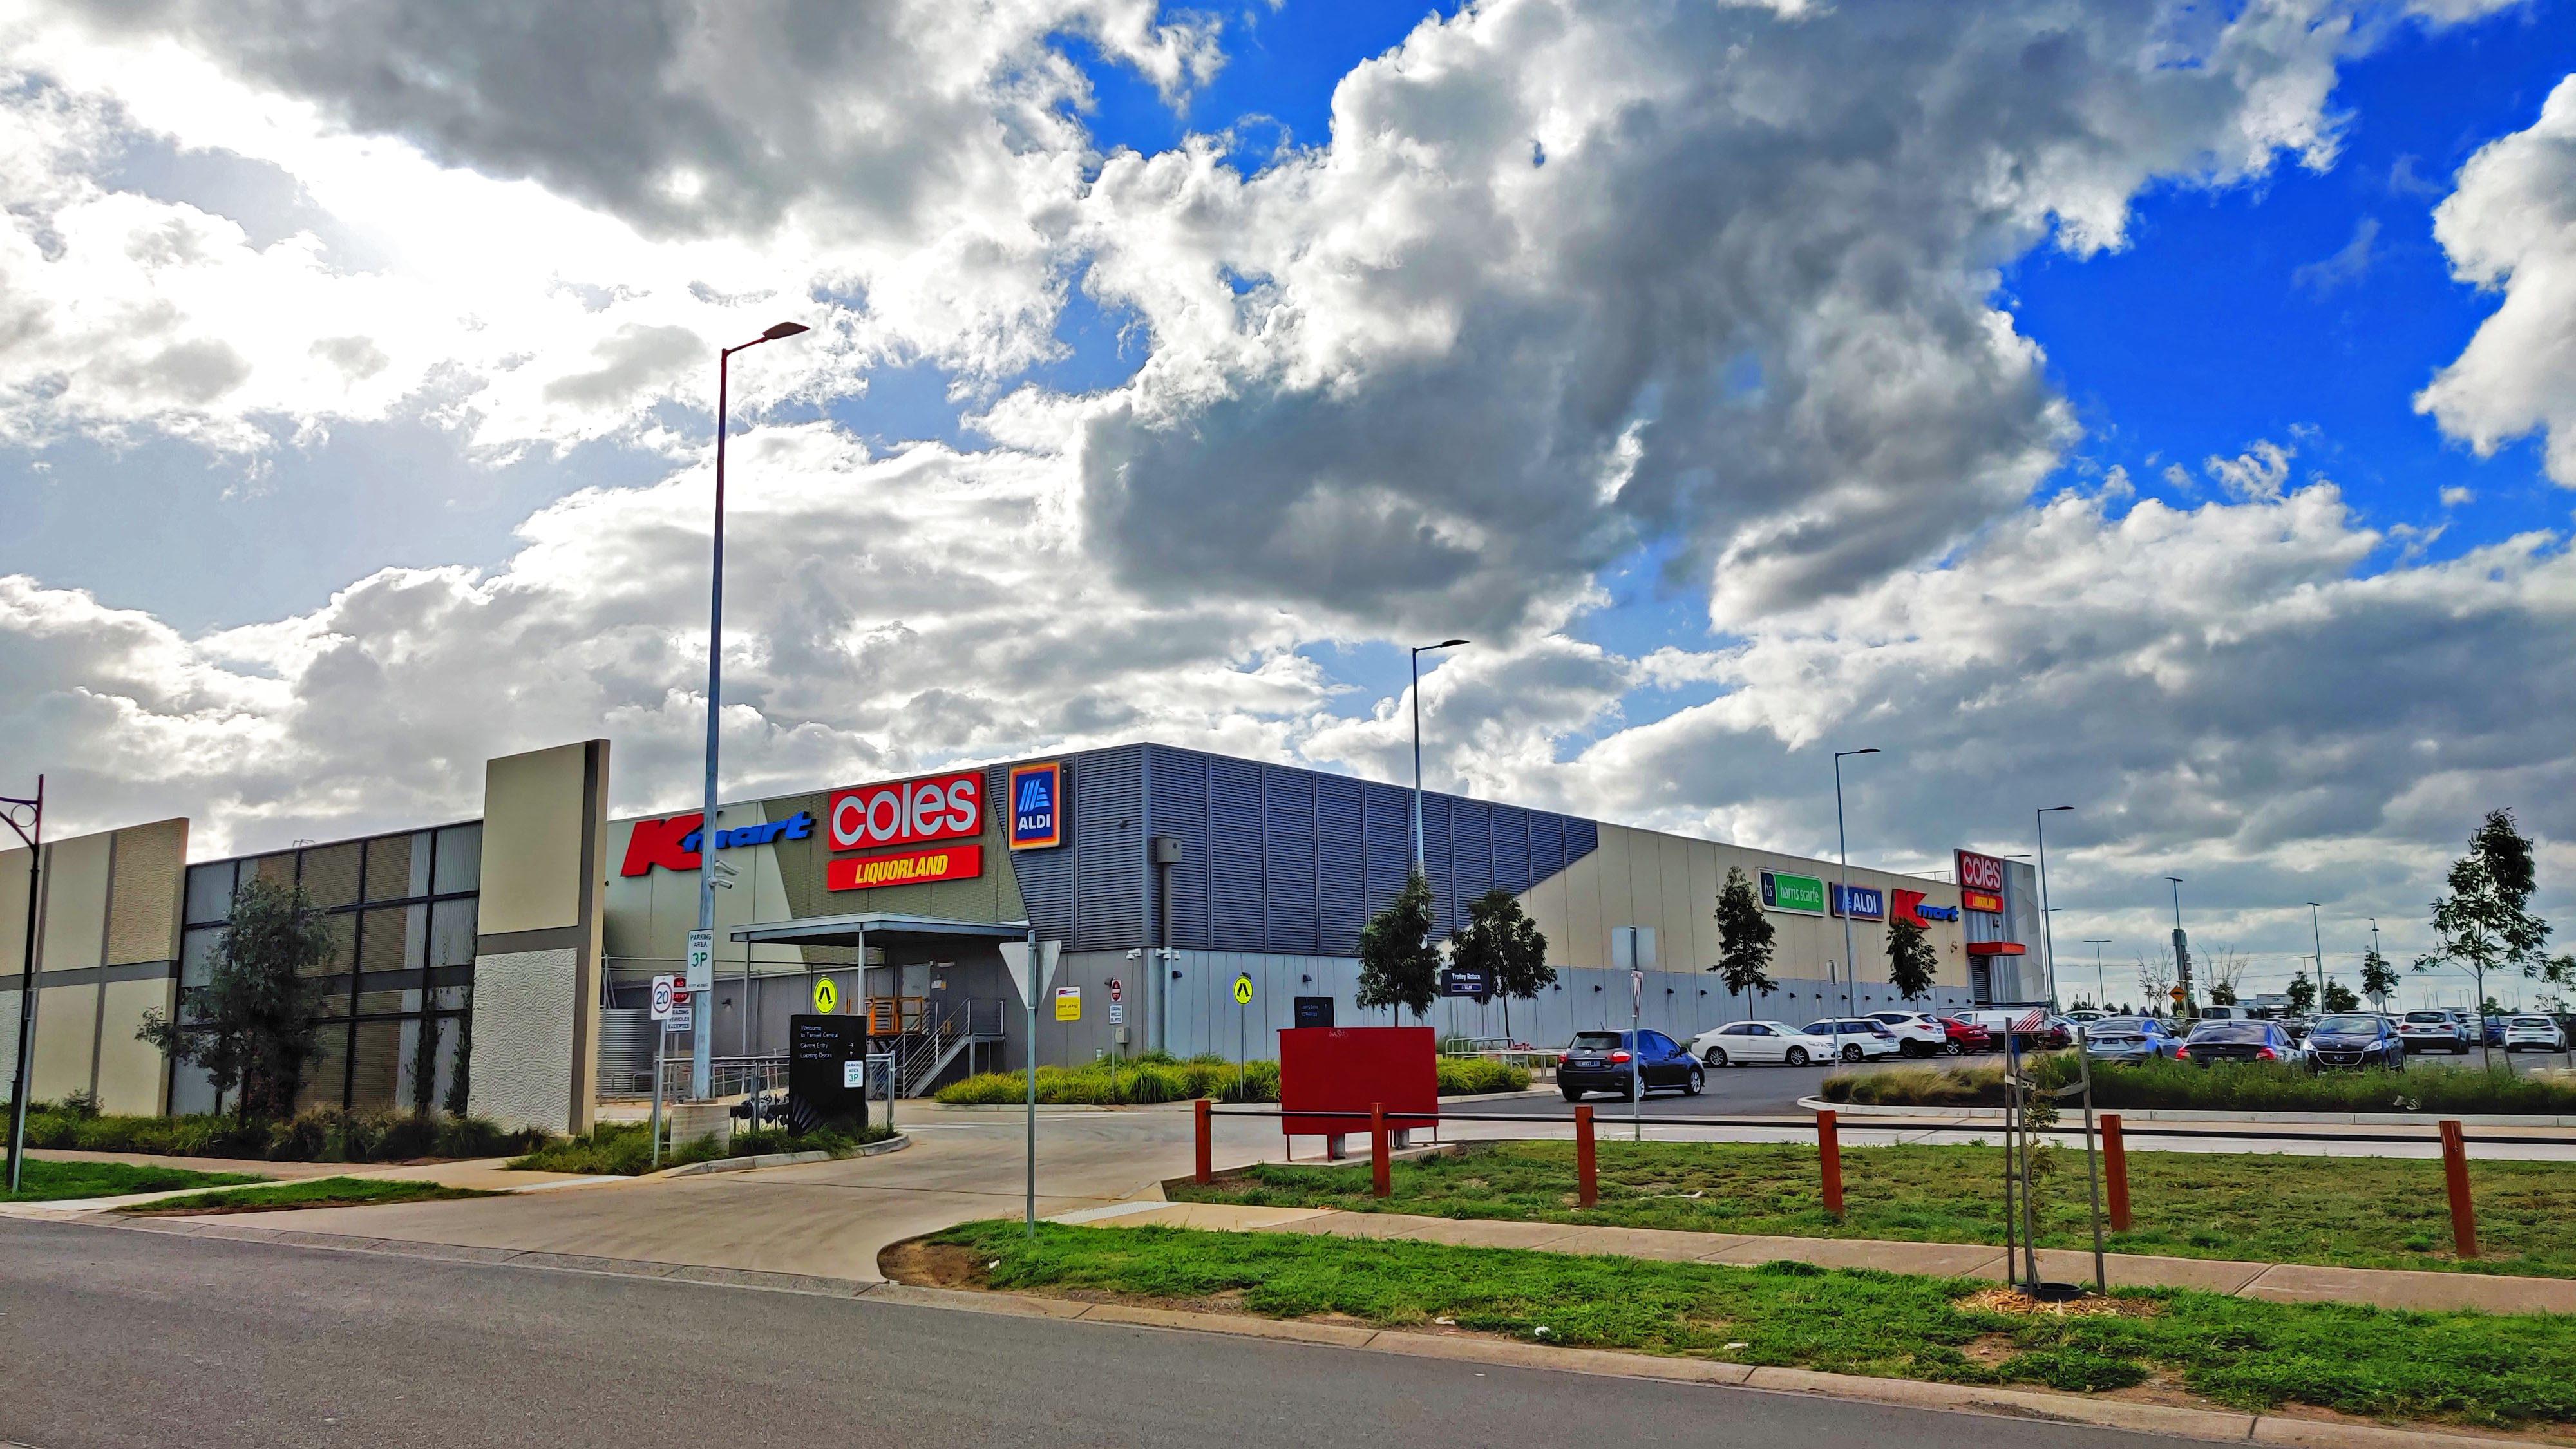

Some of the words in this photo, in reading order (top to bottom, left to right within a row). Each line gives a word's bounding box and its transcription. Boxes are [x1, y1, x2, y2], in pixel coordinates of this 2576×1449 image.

[832, 779, 976, 846] coles
[1018, 813, 1051, 831] ALDI
[855, 855, 949, 885] LIQUORLAND
[1963, 855, 2001, 888] coles
[1764, 880, 1773, 897] hs
[1780, 882, 1799, 900] harris
[1800, 886, 1819, 903] scarfe
[1853, 893, 1877, 914] ALDI
[691, 952, 708, 967] 3P
[656, 990, 669, 1005] 20
[849, 1074, 858, 1082] 3P
